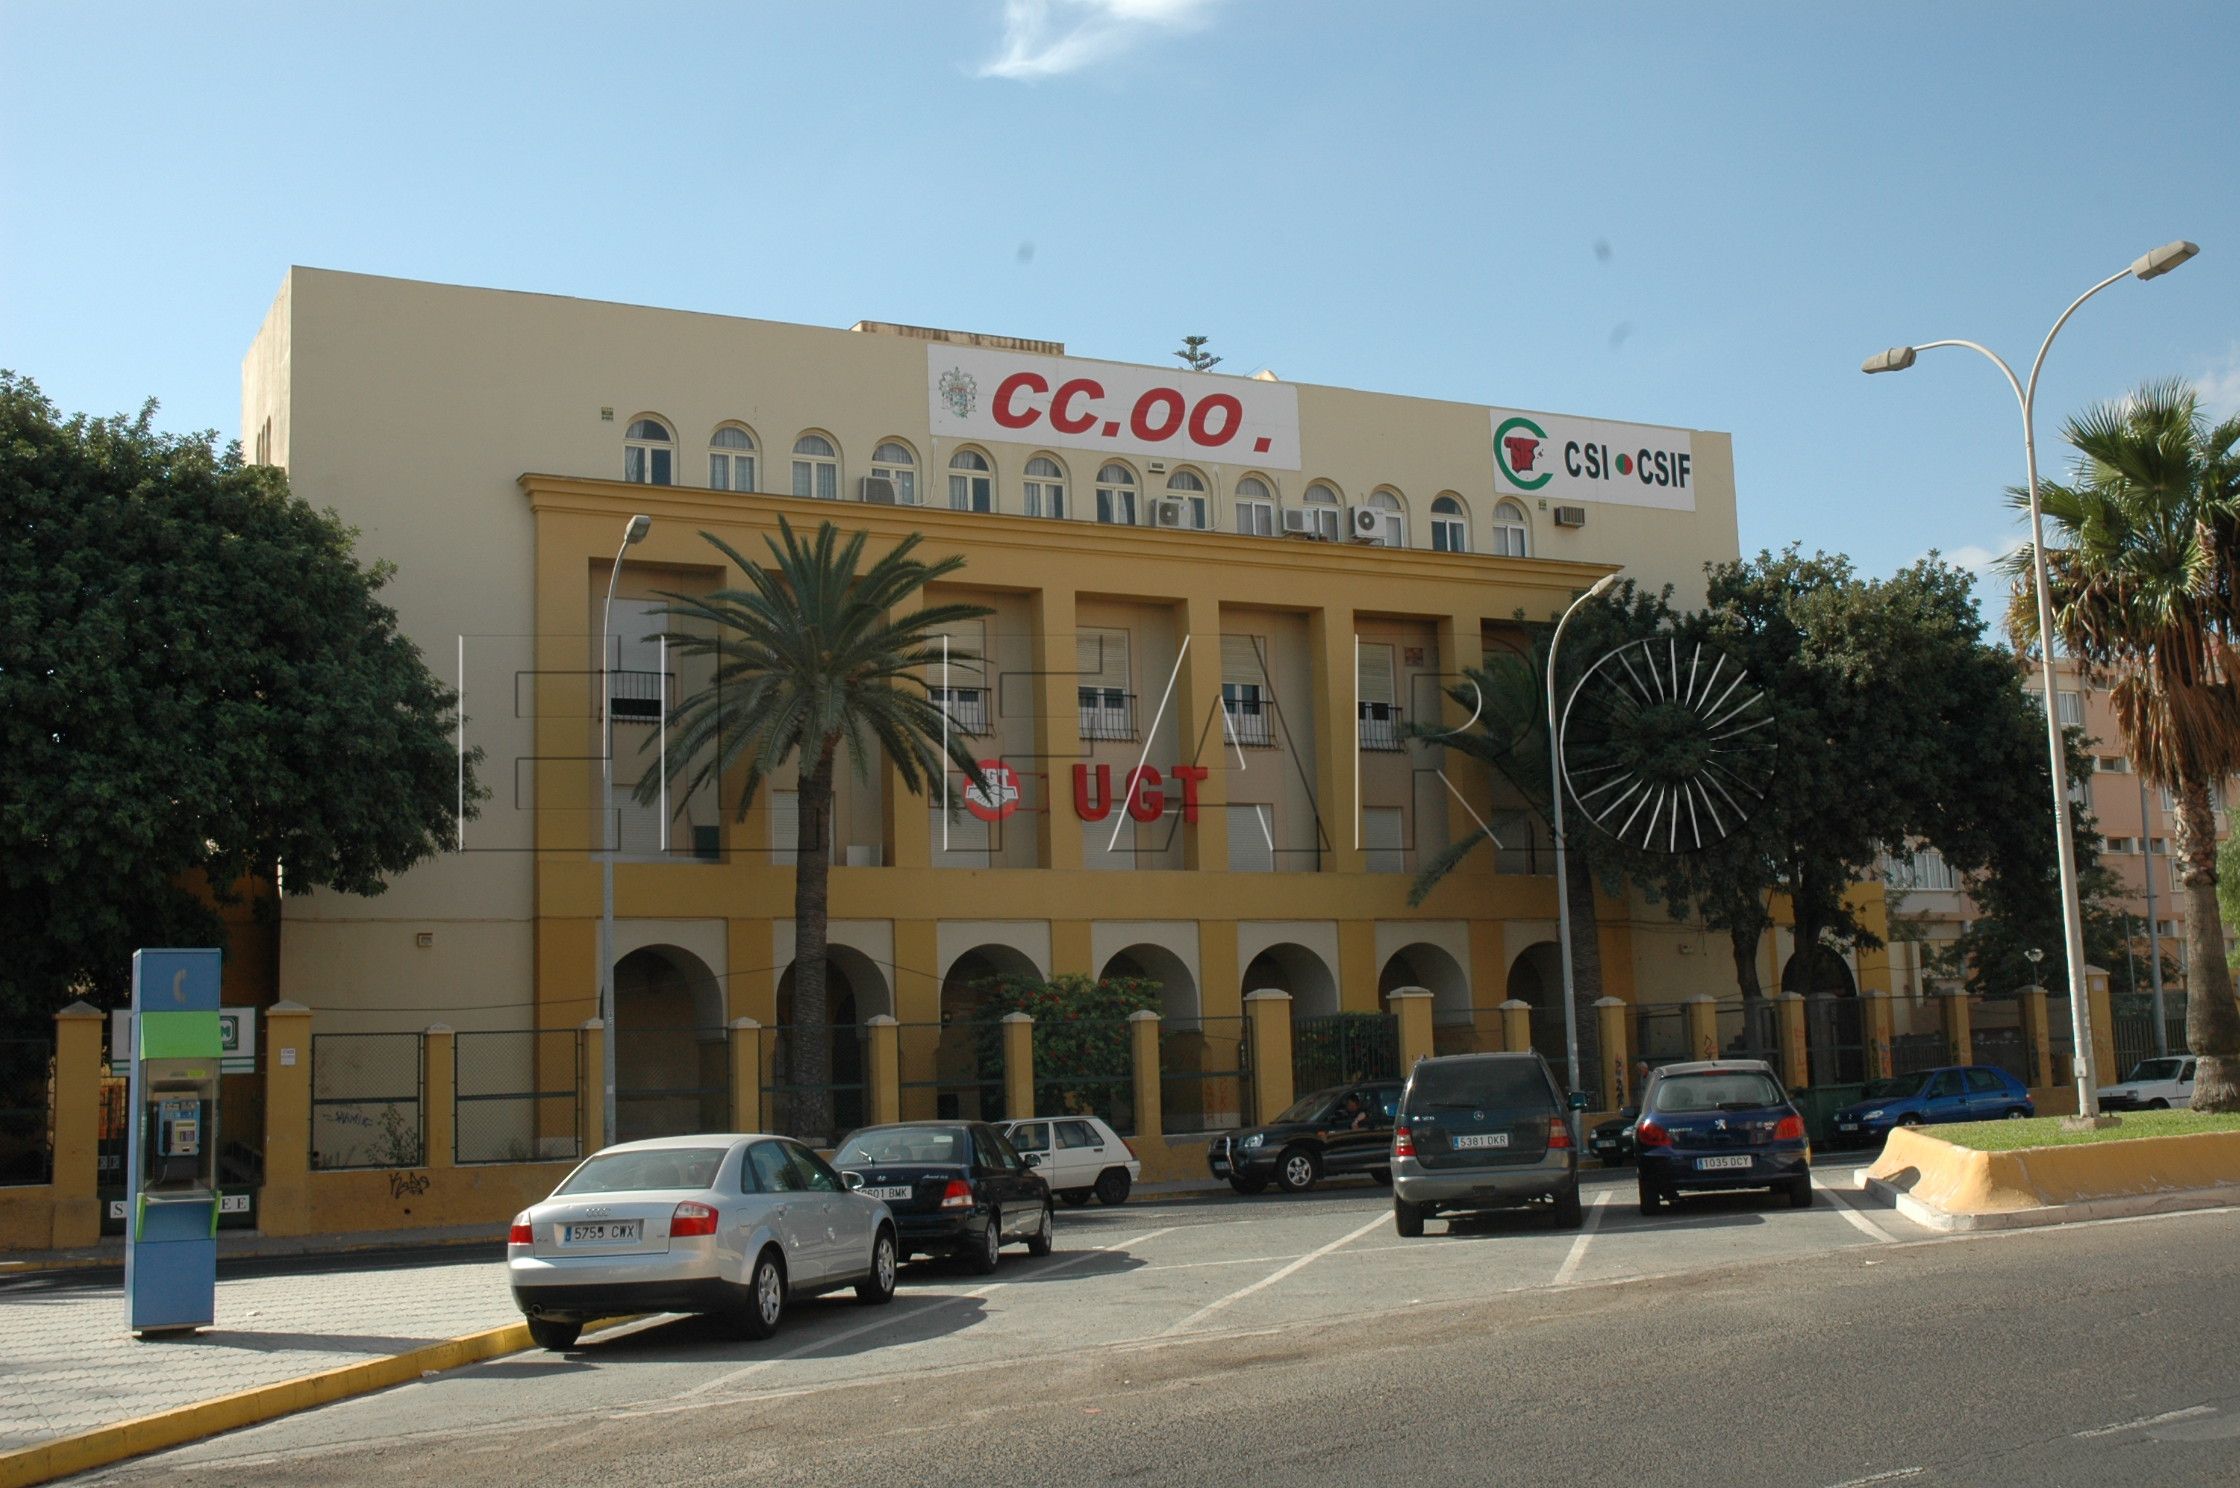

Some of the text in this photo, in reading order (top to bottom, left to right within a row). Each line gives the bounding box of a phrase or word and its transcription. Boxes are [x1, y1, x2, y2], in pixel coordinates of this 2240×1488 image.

[991, 372, 1272, 453] CC.OO.
[1564, 440, 1691, 488] CSI CSIF
[1072, 764, 1208, 823] UGT
[1460, 1137, 1484, 1147] 5381
[1705, 1158, 1728, 1168] 1035
